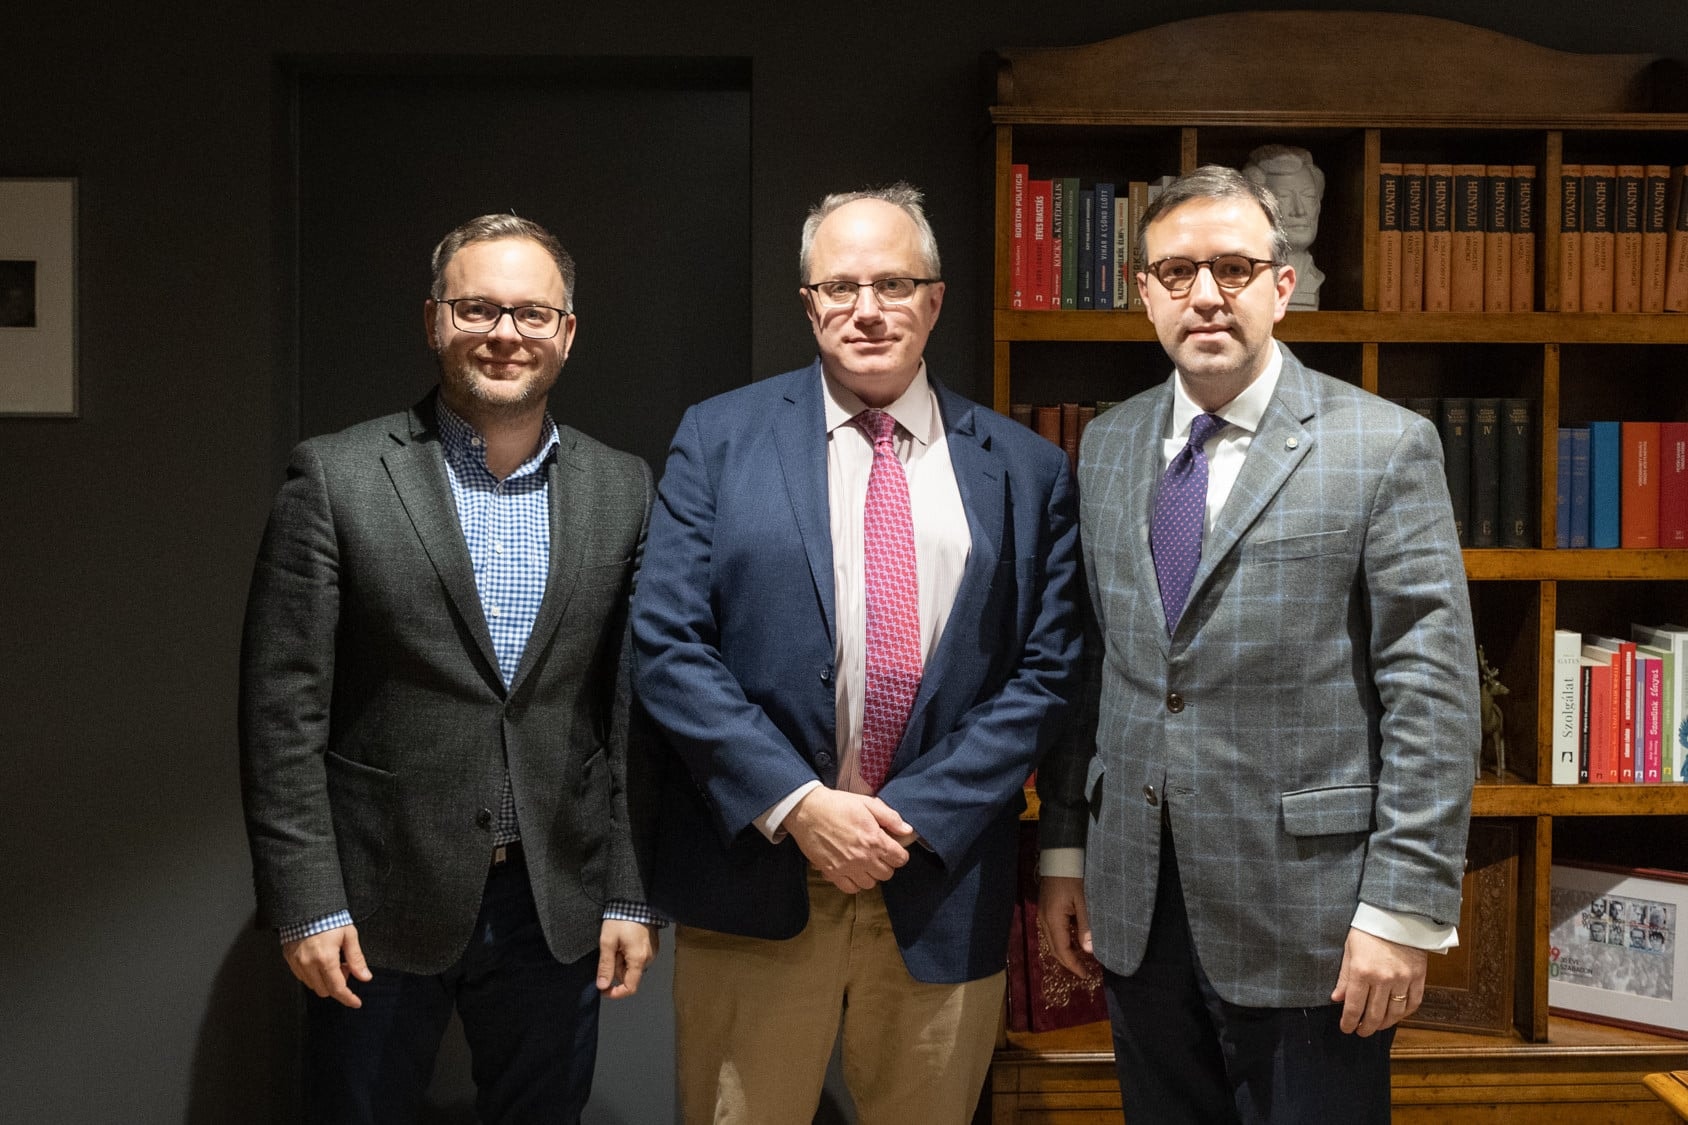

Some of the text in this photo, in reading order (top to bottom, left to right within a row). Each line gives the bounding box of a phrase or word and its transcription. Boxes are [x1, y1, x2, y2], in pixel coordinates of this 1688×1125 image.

[1034, 196, 1044, 222] RIASZTÁS
[1053, 184, 1062, 232] KATEDRÁLIS
[1386, 180, 1395, 226] HUNYADI
[1410, 180, 1420, 226] HUNYADI
[1435, 181, 1446, 227] HUNYADI
[1467, 181, 1478, 226] HUNYADI
[1496, 182, 1505, 227] HUNYADI
[1520, 182, 1530, 228] HUNYADI
[1566, 182, 1576, 227] HUNYADI
[1596, 182, 1606, 227] HUNYADI
[1627, 182, 1637, 228] HUNYADI
[1654, 182, 1665, 228] HUNYADI
[1035, 224, 1044, 240] TÉVES
[1054, 239, 1062, 267] KOCKA
[1484, 426, 1492, 435] IV
[1517, 426, 1524, 435] V
[1561, 677, 1575, 738] Szolgálat
